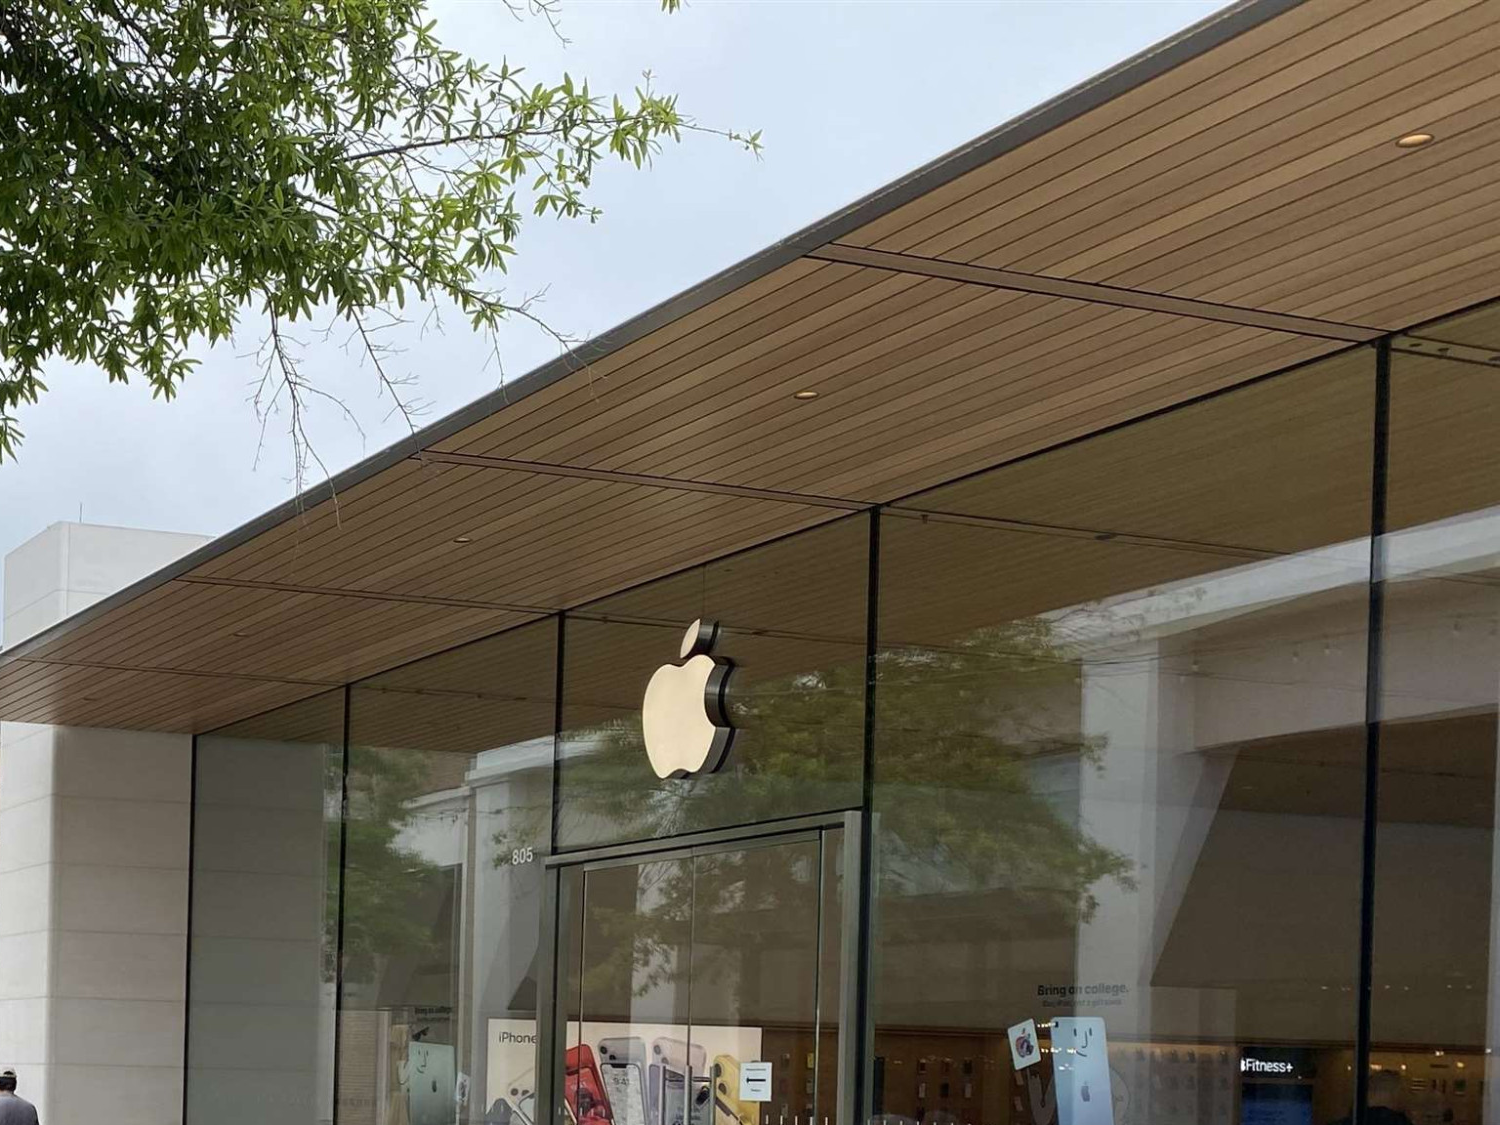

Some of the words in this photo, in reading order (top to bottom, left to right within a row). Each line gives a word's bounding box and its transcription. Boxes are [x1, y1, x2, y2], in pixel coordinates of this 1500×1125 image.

[512, 846, 533, 865] 805
[1037, 984, 1067, 998] Bring
[499, 1031, 538, 1044] iPhone
[1246, 1058, 1294, 1073] Fitness+
